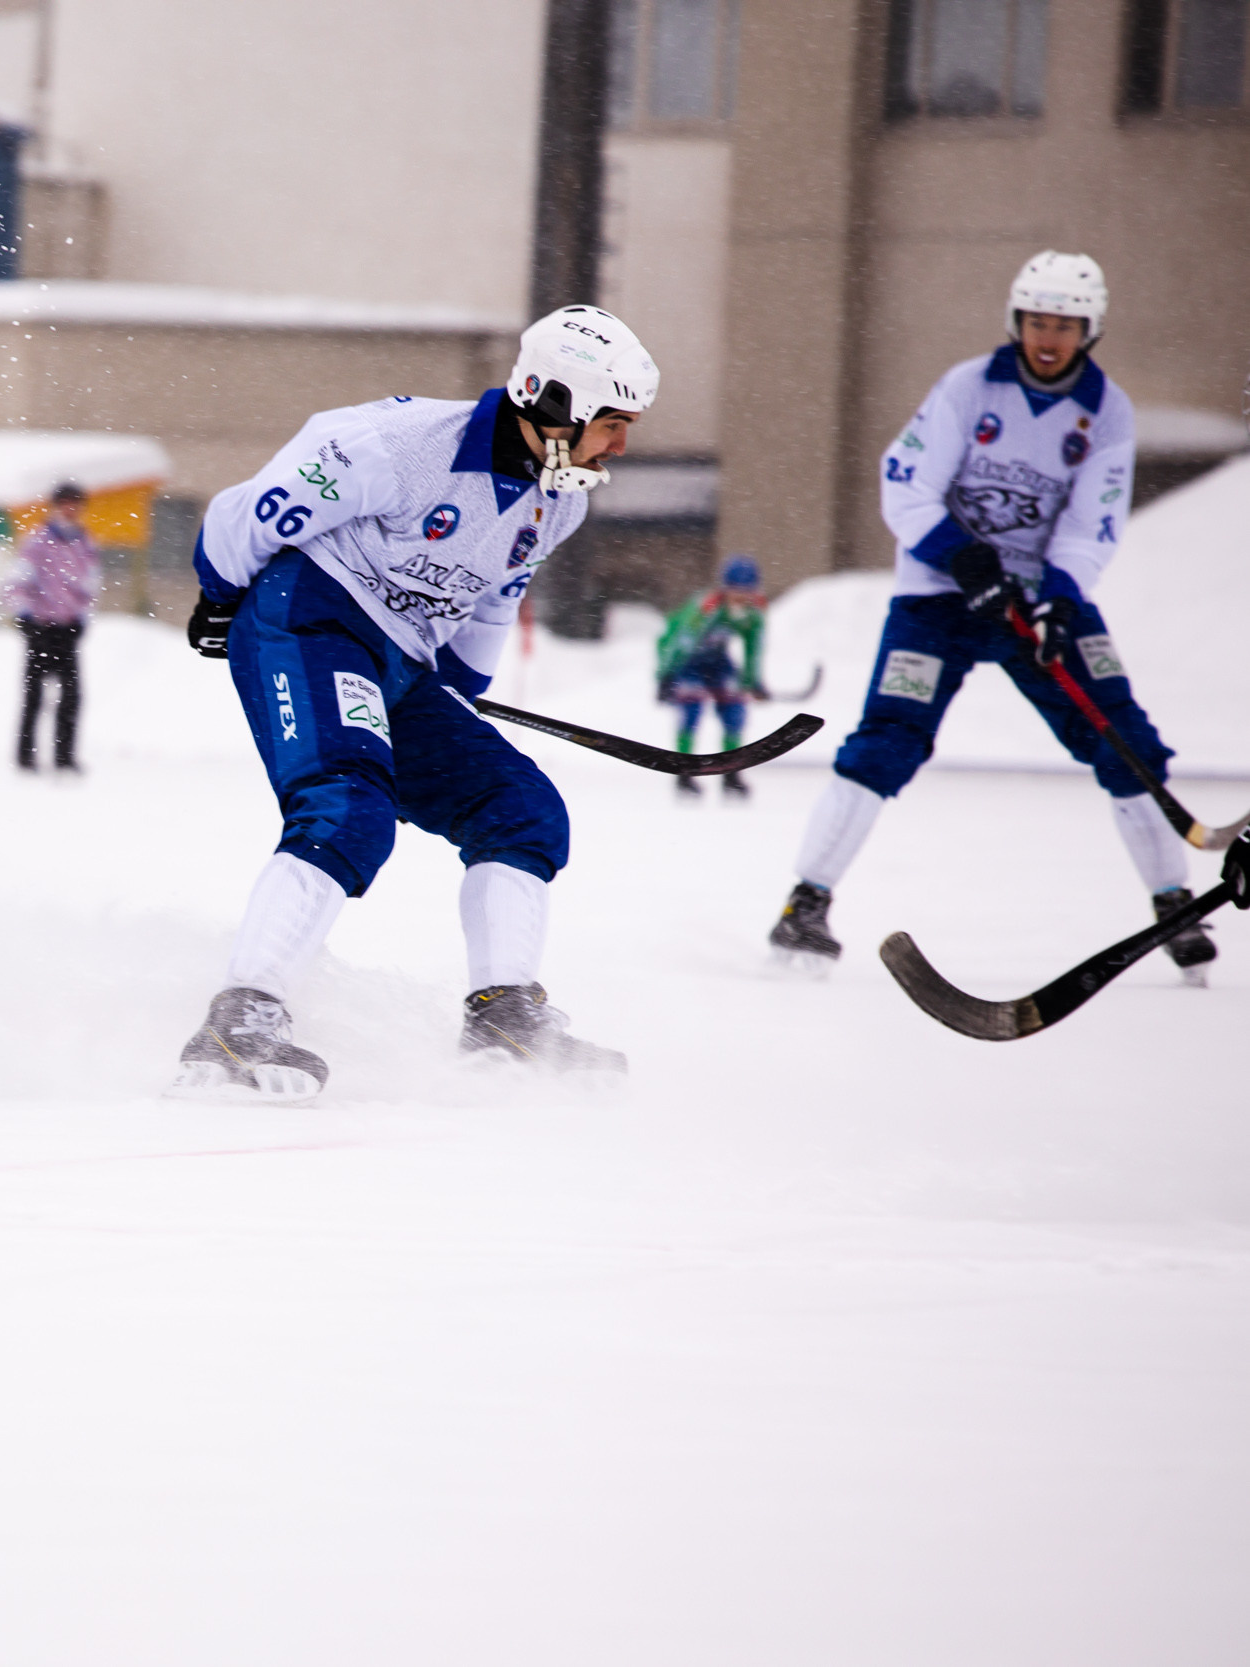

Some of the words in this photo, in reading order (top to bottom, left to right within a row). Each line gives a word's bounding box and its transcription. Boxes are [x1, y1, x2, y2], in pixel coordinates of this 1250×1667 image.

[563, 321, 612, 345] CCM
[255, 487, 313, 538] 66
[273, 672, 298, 741] STEX
